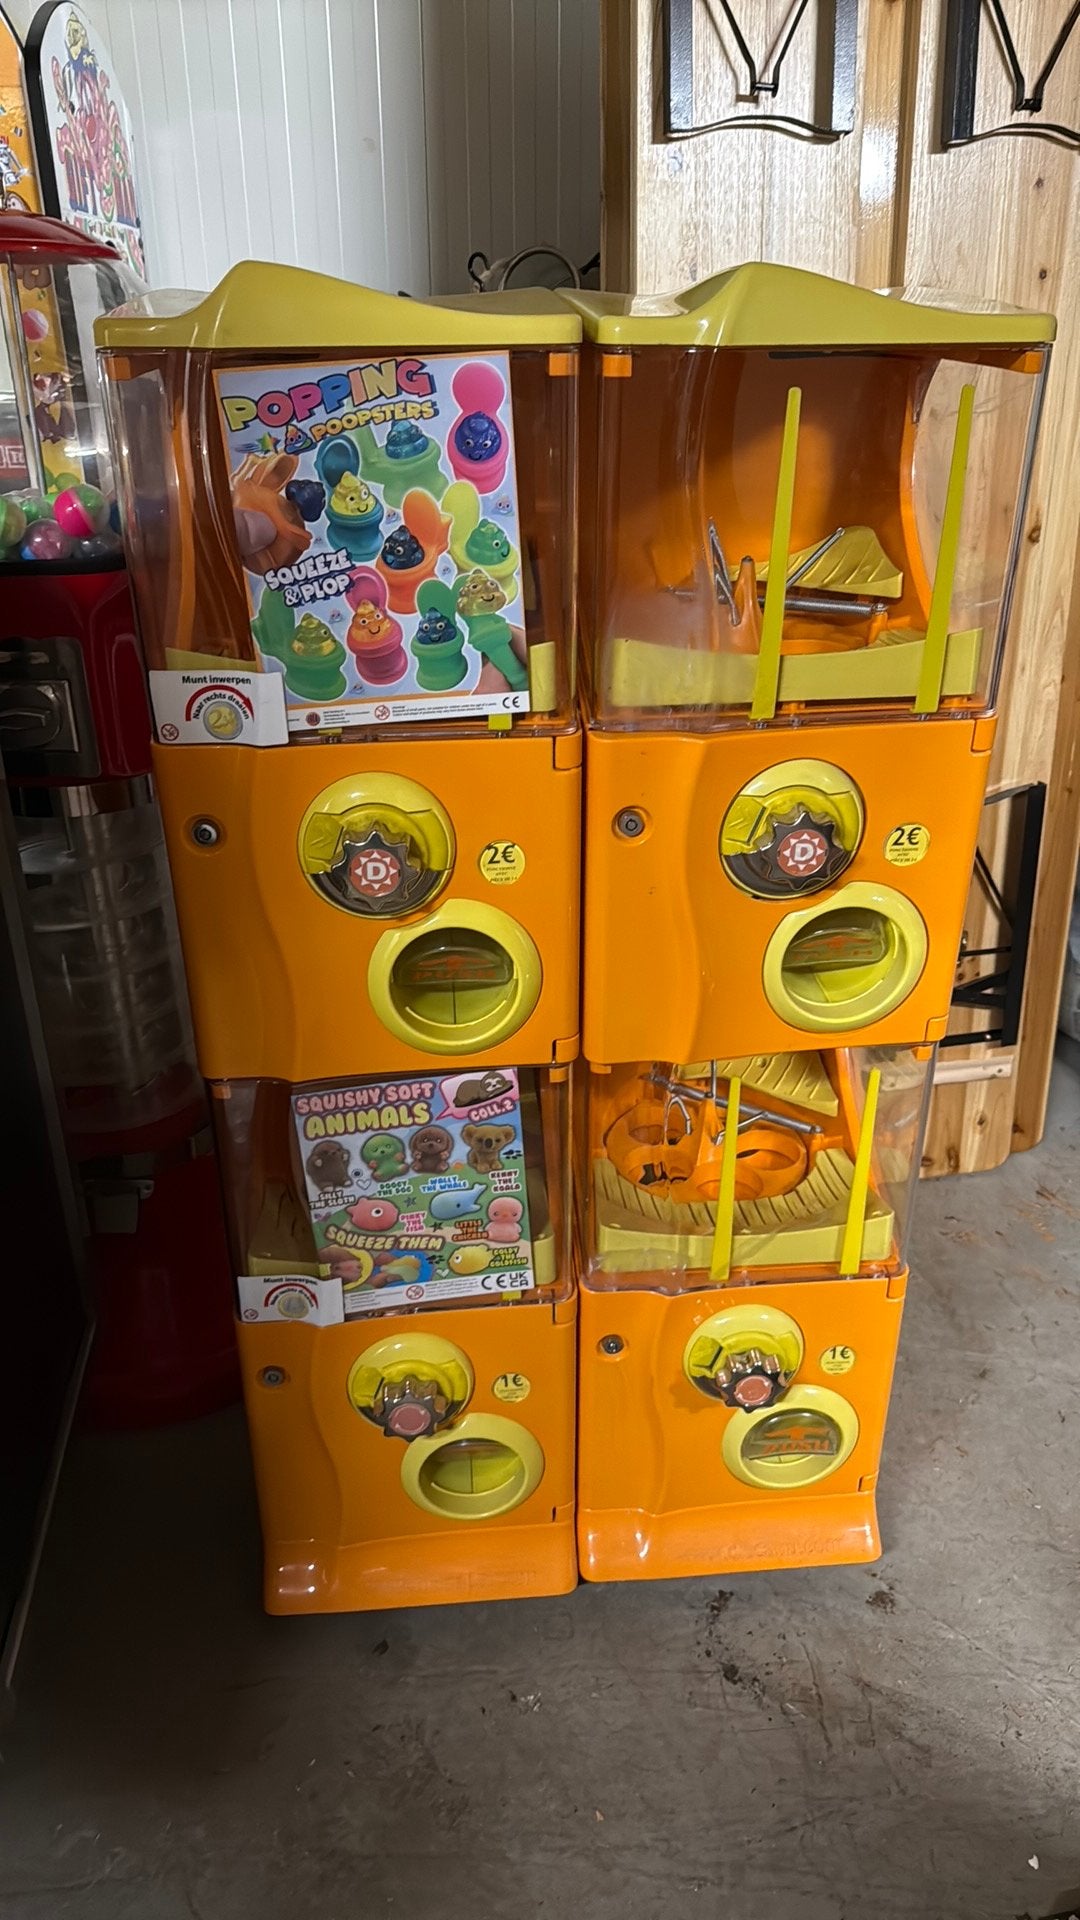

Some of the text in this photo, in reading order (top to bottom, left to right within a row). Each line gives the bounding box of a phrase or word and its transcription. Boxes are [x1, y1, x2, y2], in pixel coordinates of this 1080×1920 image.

[221, 359, 436, 431] POPPING
[309, 400, 438, 442] POOPSTERS
[264, 547, 352, 591] SQUEEZE
[284, 573, 351, 607] & PLOP
[182, 675, 251, 685] Munt inwerpen
[193, 692, 249, 719] Naar rechts draaien
[502, 696, 520, 709] CE
[892, 827, 921, 846] 2€
[486, 844, 516, 864] 2€
[794, 843, 814, 861] D
[367, 862, 387, 881] D
[296, 1081, 435, 1115] SQUISHY SOFT
[304, 1101, 432, 1140] ANIMALS
[493, 1184, 520, 1192] KOALA
[309, 1195, 356, 1209] THE SLOTH
[325, 1224, 446, 1251] SQUEEZE THEM
[481, 1273, 507, 1290] CE
[509, 1272, 527, 1280] UK
[509, 1279, 529, 1287] CA
[829, 1345, 850, 1359] 1€
[500, 1373, 523, 1387] 1€
